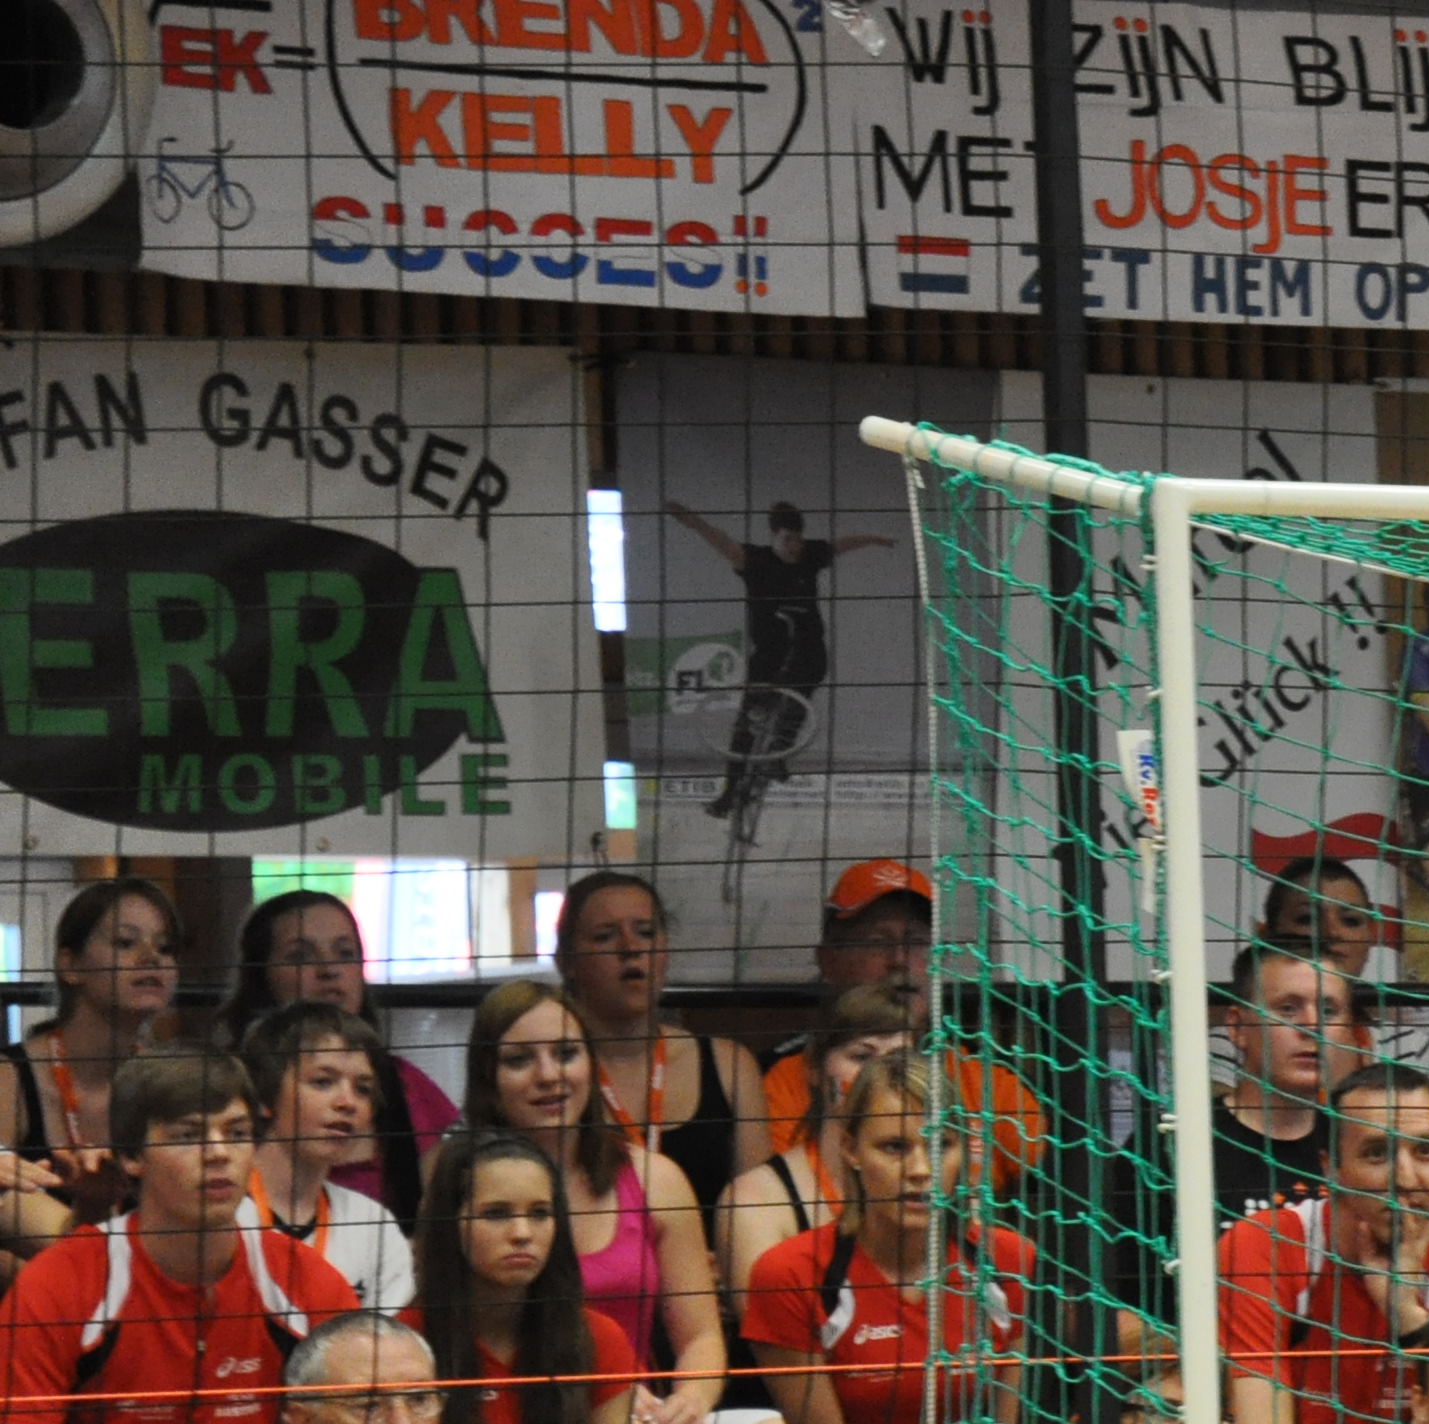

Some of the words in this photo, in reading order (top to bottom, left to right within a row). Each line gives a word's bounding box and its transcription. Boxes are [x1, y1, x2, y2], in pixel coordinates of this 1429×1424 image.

[353, 0, 770, 65] BRENDA
[388, 87, 733, 184] KELLY
[872, 124, 1043, 218] ME
[1191, 256, 1313, 317] HEM
[200, 372, 511, 541] GASSER
[136, 752, 514, 817] MOBILE
